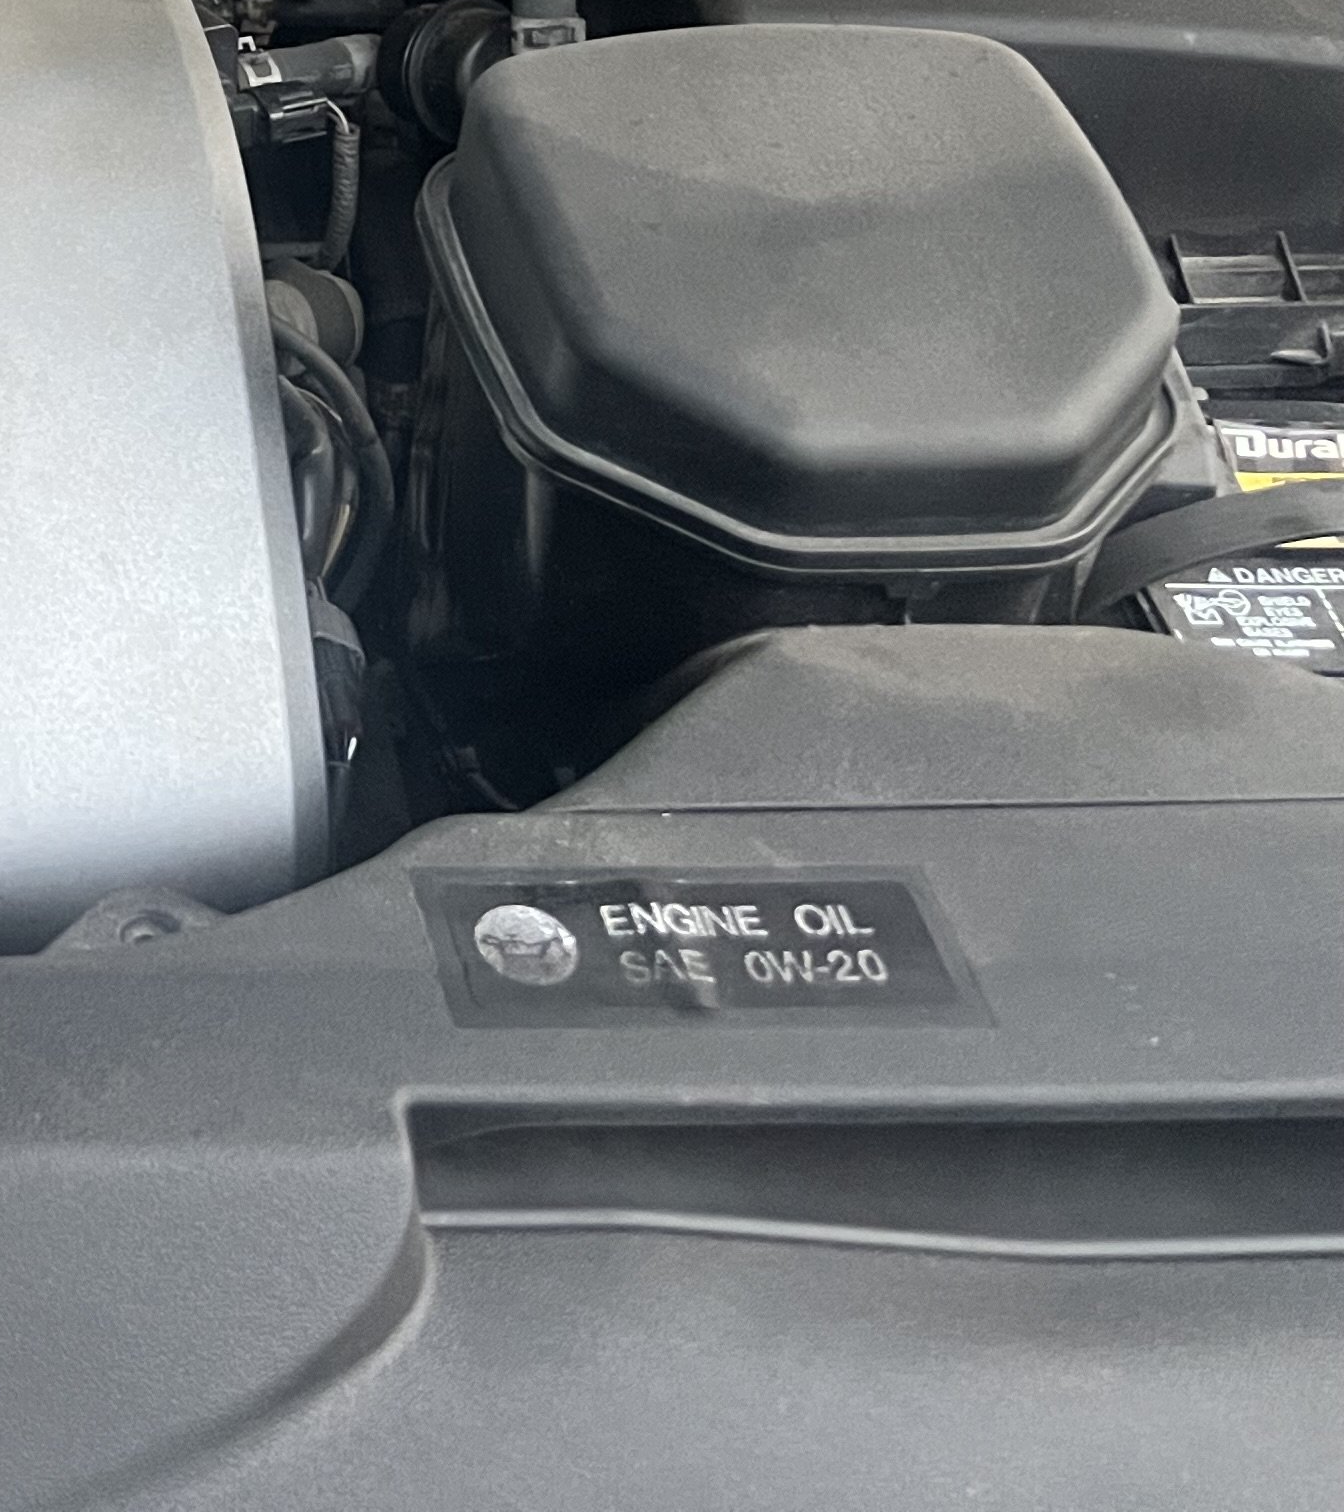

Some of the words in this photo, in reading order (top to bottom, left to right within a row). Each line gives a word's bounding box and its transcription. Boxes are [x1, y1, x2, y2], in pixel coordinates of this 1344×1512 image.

[1234, 428, 1344, 459] Dura
[599, 901, 768, 939] ENGINE
[794, 903, 876, 938] OIL
[618, 948, 717, 985] SAE
[744, 949, 889, 985] 0W-20
